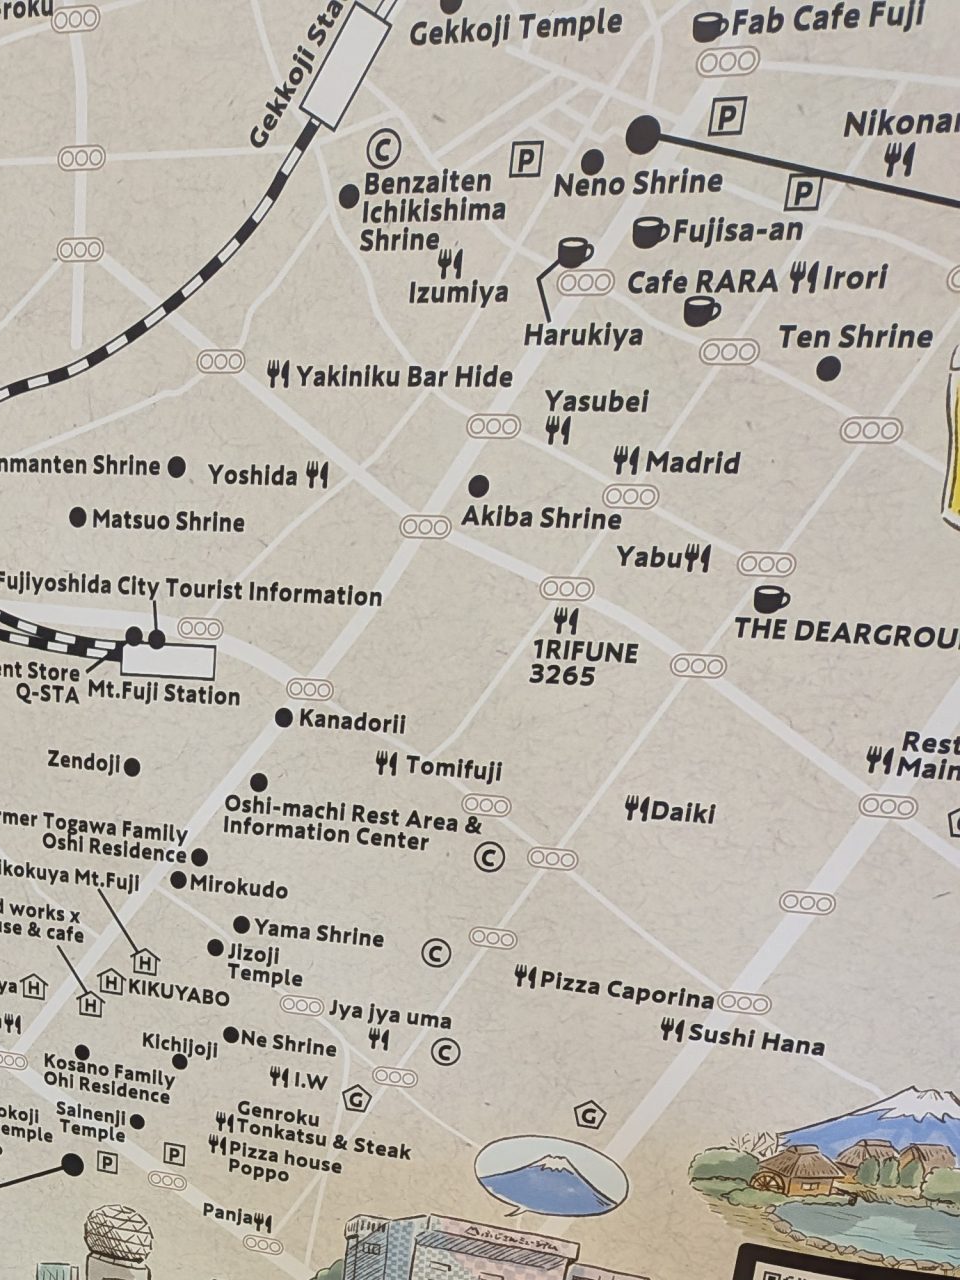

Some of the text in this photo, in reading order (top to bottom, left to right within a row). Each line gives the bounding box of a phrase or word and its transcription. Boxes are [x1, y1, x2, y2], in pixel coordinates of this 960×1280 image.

[410, 8, 623, 47] Gekkoji Temple
[732, 0, 924, 36] Fab Cafe Fuji
[364, 170, 492, 195] Benzaiten
[554, 168, 723, 198] Neno Shrine
[362, 197, 506, 224] Ichikishima
[360, 228, 439, 252] Shrine
[673, 217, 804, 248] Fujisa-an
[627, 270, 779, 294] Cafe RARA
[823, 264, 889, 290] Irori
[409, 282, 509, 307] Izumiya
[524, 322, 643, 352] Harukiya
[778, 323, 934, 349] Ten Shrine
[296, 366, 513, 388] Yakiniku Bar Hide
[545, 389, 650, 413] Yasubei
[93, 454, 160, 476] Shrine
[208, 463, 298, 487] Yoshida
[645, 450, 741, 475] Madrid
[93, 509, 245, 533] Matsuo Shrine
[461, 505, 622, 531] Akiba Shrine
[616, 545, 682, 569] Yabu
[118, 576, 159, 600] City
[166, 578, 243, 600] Tourist
[250, 581, 383, 607] Information
[734, 617, 960, 650] THE DEARGROU
[27, 662, 80, 682] Store
[529, 664, 595, 687] 3265
[15, 682, 80, 704] Q-STA
[88, 679, 240, 706] Mt.Fuji Station
[299, 708, 407, 735] Kanadorii
[48, 750, 120, 775] Zendoji
[407, 755, 503, 784] Tomifuji
[651, 799, 716, 825] Daiki
[190, 873, 289, 900] Mirokudo
[254, 918, 385, 948] Yama Shrine
[128, 979, 230, 1007] KIKUYABO
[540, 970, 715, 1010] Pizza Caporina
[142, 1032, 218, 1059] Kichijoji
[241, 1030, 337, 1058] Ne Shrine
[688, 1024, 826, 1058] Sushi Hana
[56, 1101, 126, 1126] Sainenji
[60, 1119, 126, 1143] Temple
[203, 1203, 254, 1226] Panja
